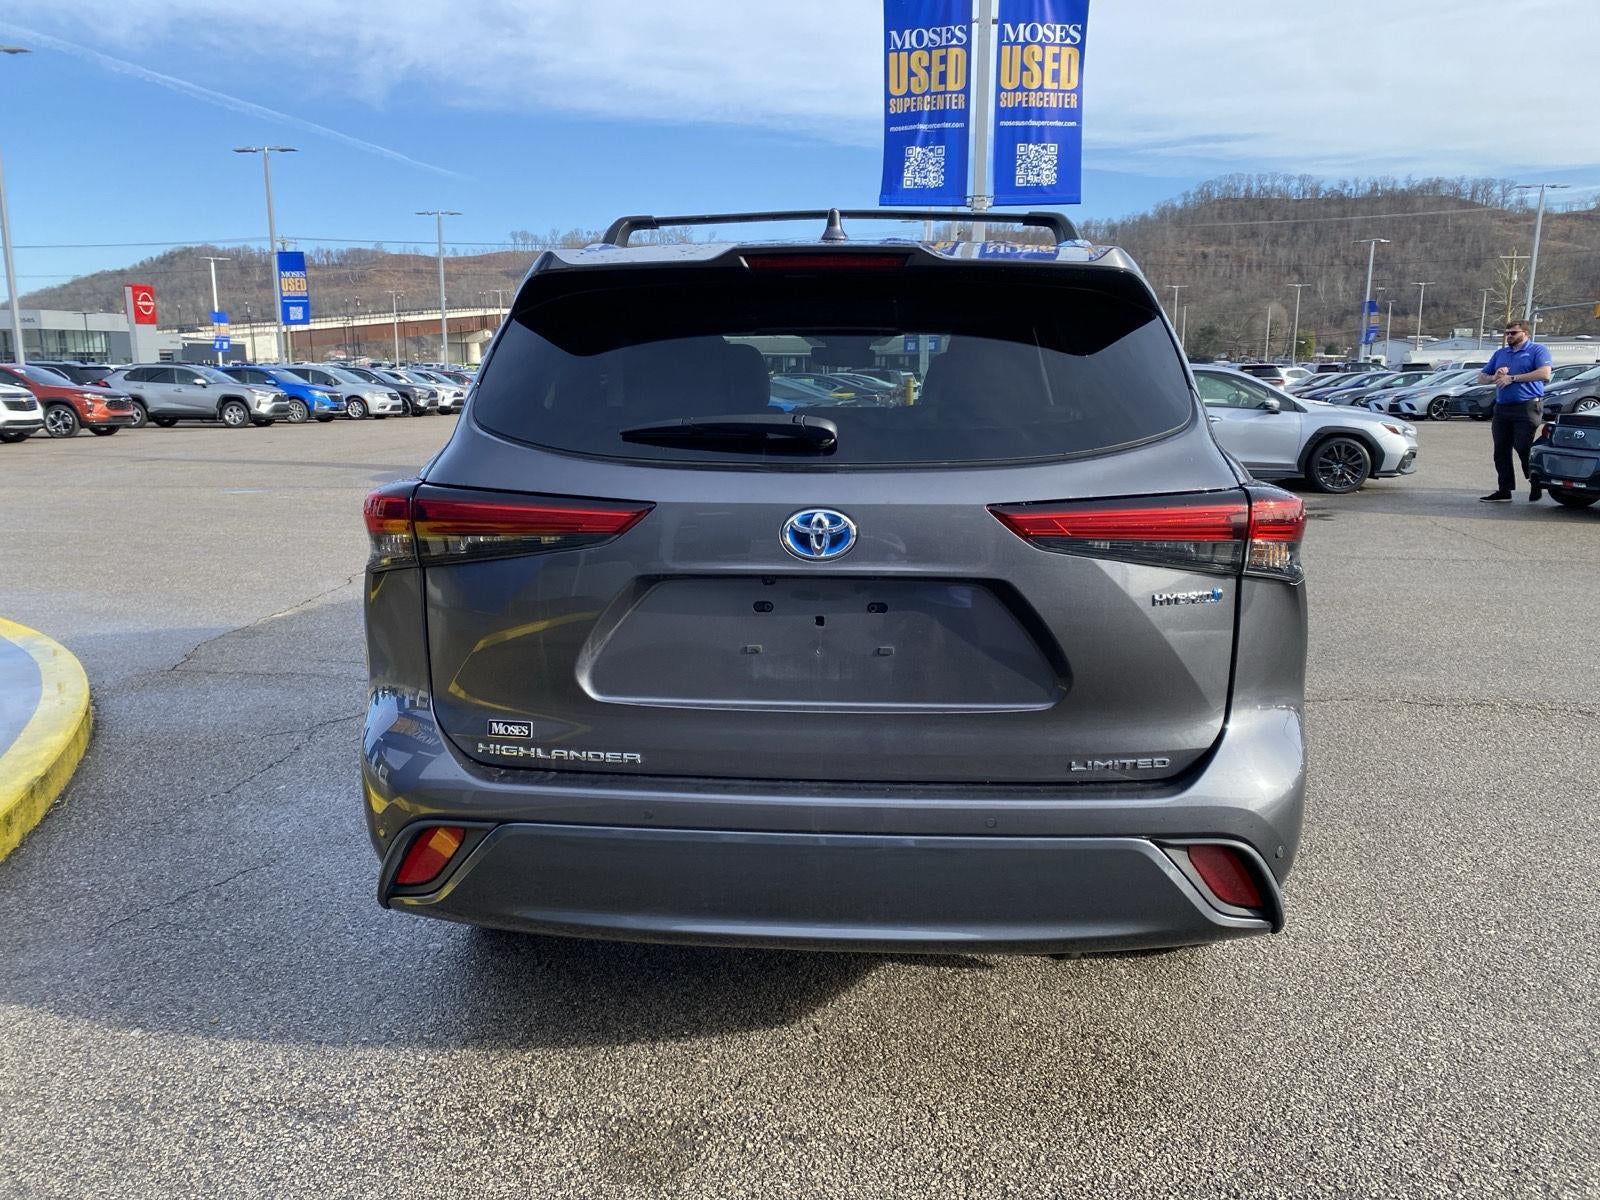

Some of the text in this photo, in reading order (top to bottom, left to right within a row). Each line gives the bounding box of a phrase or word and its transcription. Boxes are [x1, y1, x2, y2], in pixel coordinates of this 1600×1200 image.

[889, 25, 967, 50] MOSES
[1002, 22, 1082, 44] MOSES
[888, 47, 967, 96] USED
[1000, 44, 1080, 91] USED
[889, 93, 965, 114] SUPERCENTER
[1000, 91, 1078, 109] SUPERCENTER
[889, 121, 965, 132] mosesusedsupercenter.com
[1000, 119, 1077, 128] mosesusedsupercenter.com
[281, 277, 307, 292] USED
[491, 722, 529, 736] MOSES
[477, 742, 642, 764] HIGHLANDER
[1071, 758, 1170, 772] LIMITED
